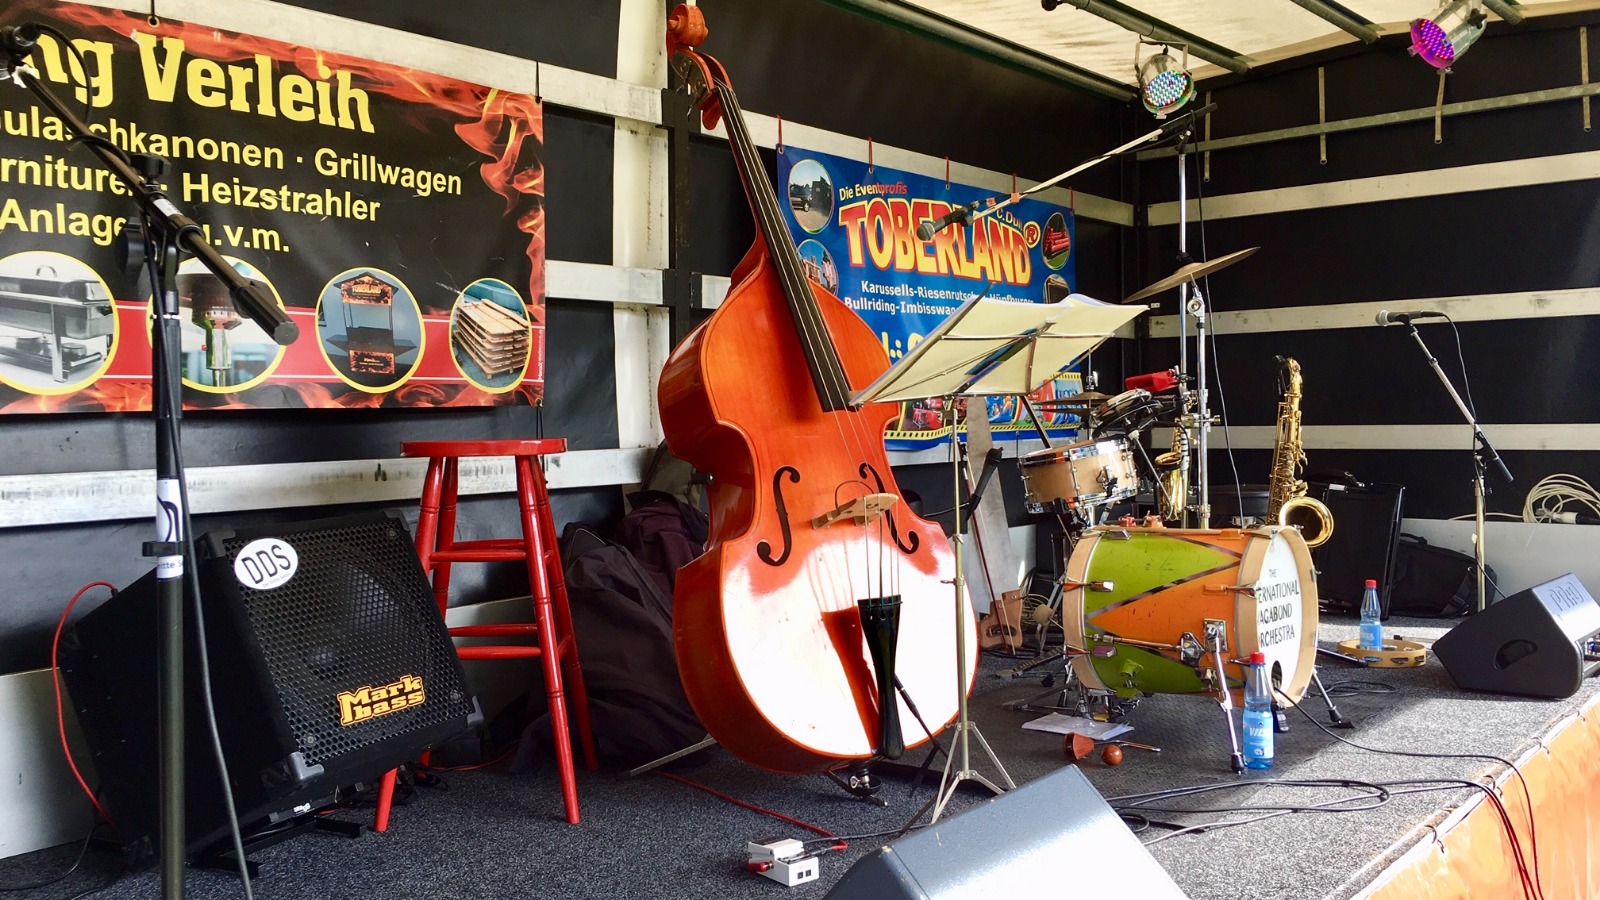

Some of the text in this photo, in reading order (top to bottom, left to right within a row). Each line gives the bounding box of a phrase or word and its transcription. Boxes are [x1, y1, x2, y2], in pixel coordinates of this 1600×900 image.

[135, 31, 375, 134] Verleih
[0, 105, 462, 196] ulahkanonen Grillwagen
[1, 155, 380, 222] rniture Heizstrahler
[839, 181, 908, 201] Die Eventprofis
[0, 198, 127, 246] Anlage
[839, 198, 1031, 286] TOBERLAND
[241, 544, 292, 585] DDS
[1269, 568, 1277, 578] THE
[1259, 624, 1295, 648] RCHESTRA
[338, 675, 423, 725] Mark
[353, 690, 423, 720] bass
